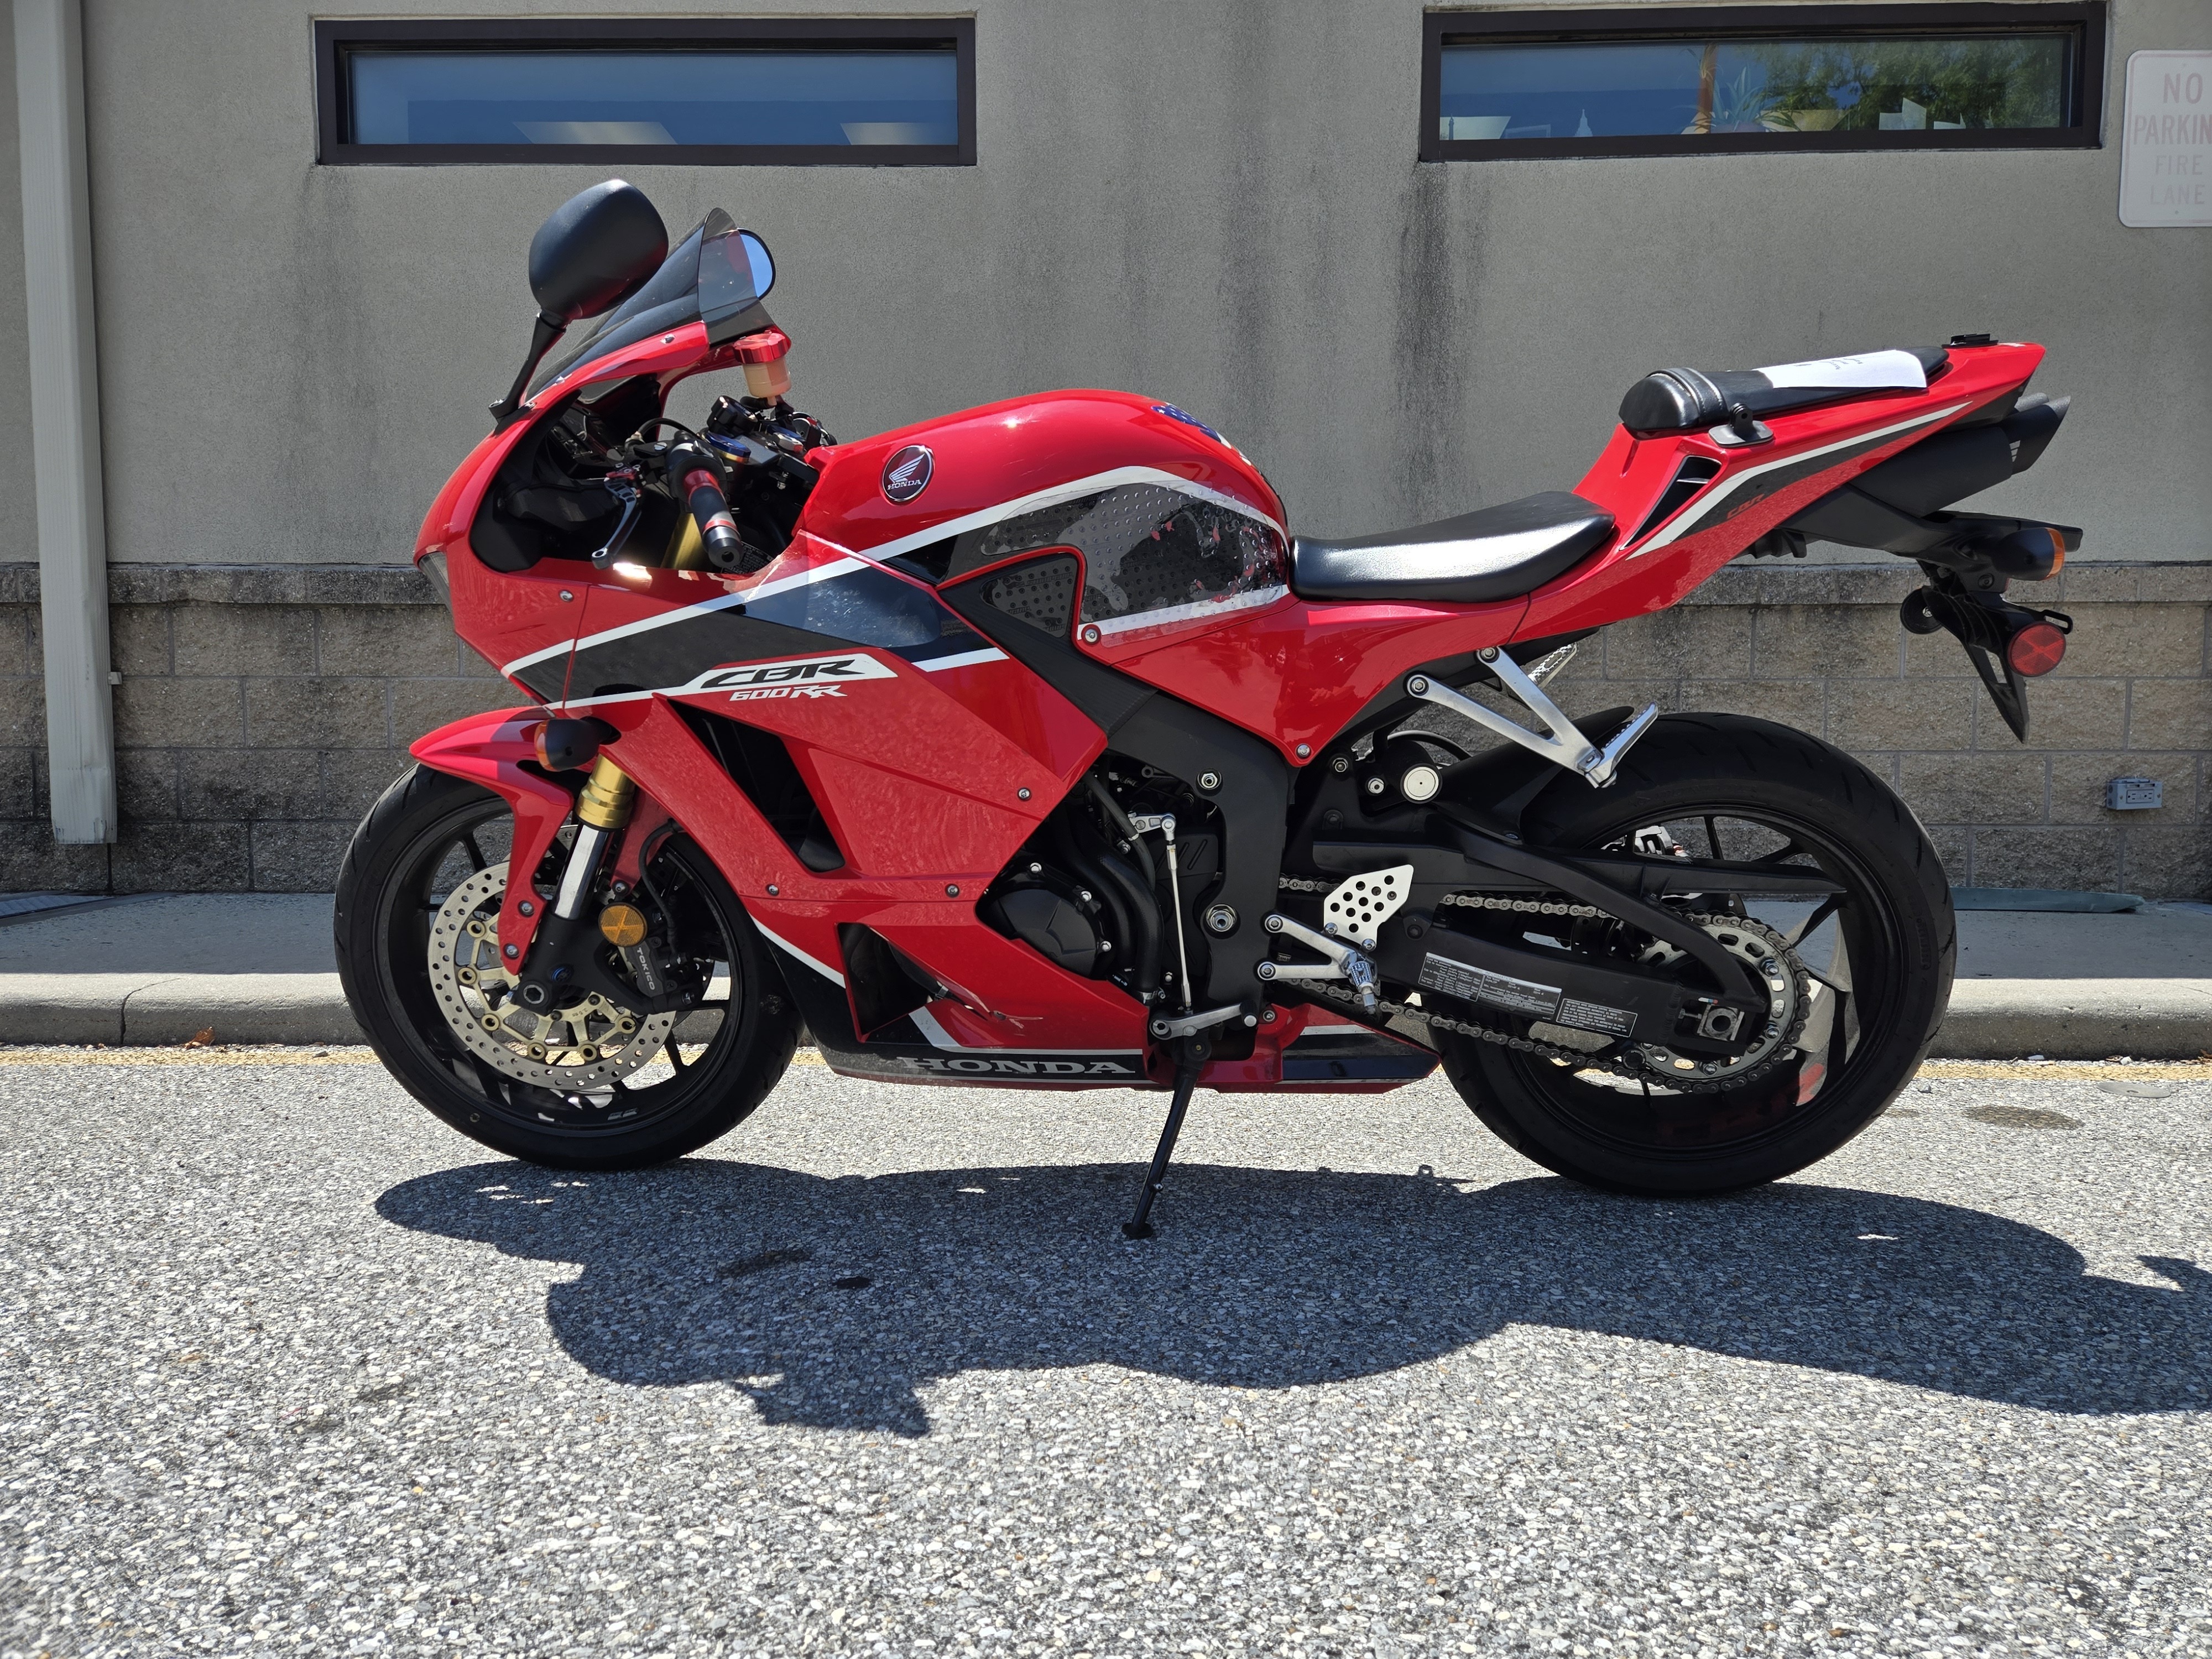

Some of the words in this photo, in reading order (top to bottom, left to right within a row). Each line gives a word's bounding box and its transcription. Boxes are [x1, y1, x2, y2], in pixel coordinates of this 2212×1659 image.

[2163, 72, 2203, 104] NO
[2156, 155, 2203, 175] FIRE
[2150, 184, 2205, 205] LANE
[887, 479, 922, 490] HONDA
[1727, 493, 1765, 519] CBR
[700, 659, 866, 689] CBR
[729, 685, 848, 702] 600RR
[637, 947, 655, 990] TOKICO
[896, 1056, 1136, 1074] HONDA
